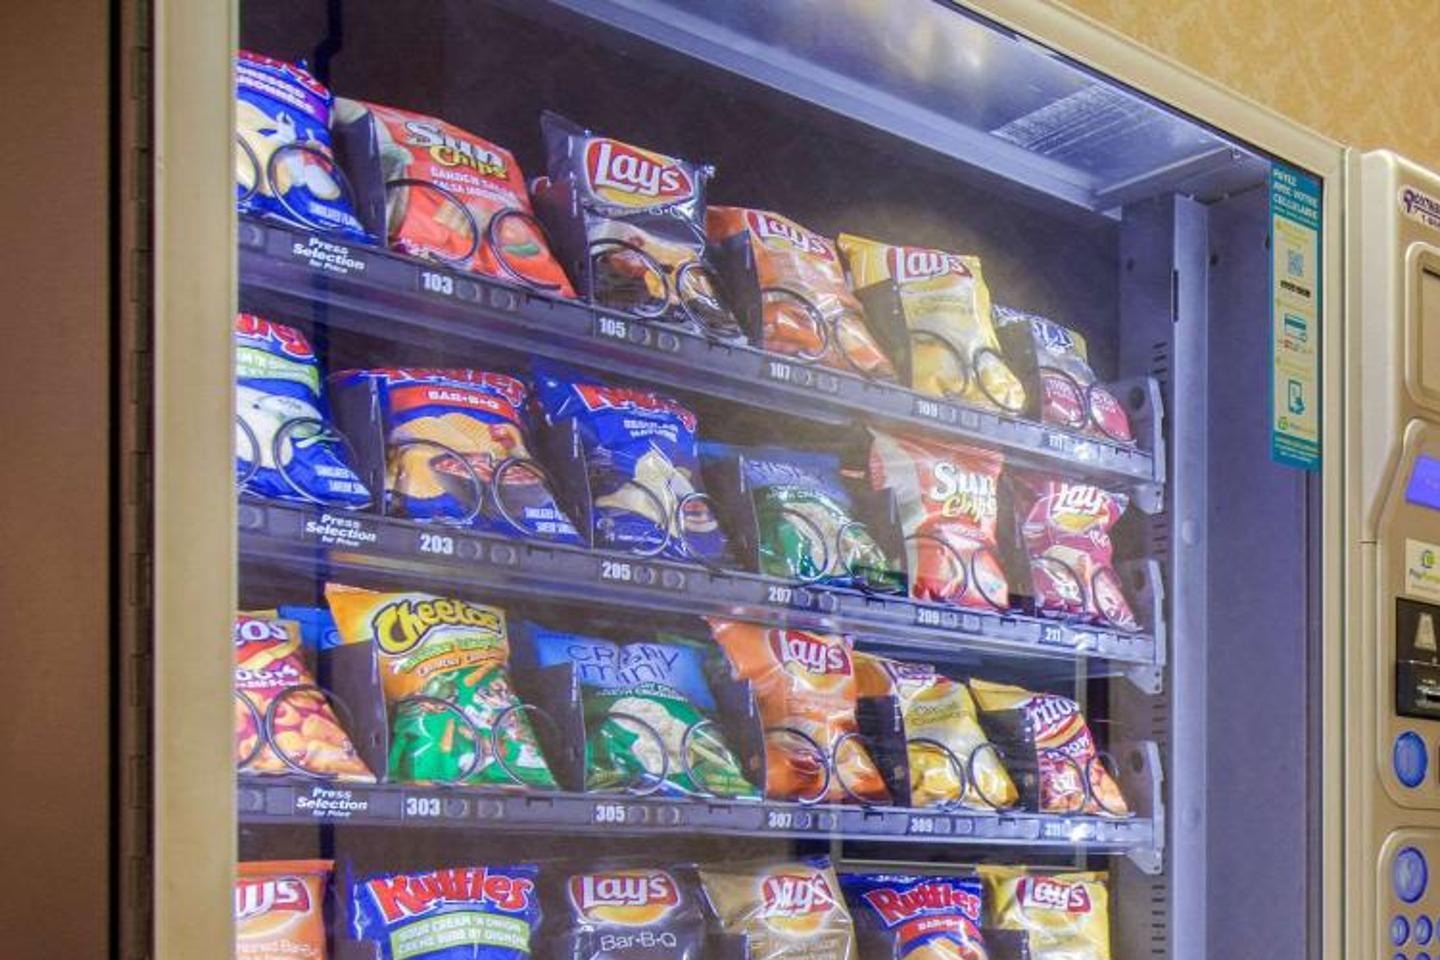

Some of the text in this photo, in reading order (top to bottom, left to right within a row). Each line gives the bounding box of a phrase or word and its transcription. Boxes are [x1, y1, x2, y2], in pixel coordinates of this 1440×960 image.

[293, 243, 365, 271] Selection
[308, 237, 349, 257] Press
[421, 272, 454, 296] 103
[599, 318, 628, 340] 105
[321, 513, 361, 531] Press
[305, 521, 377, 545] Selection
[420, 534, 454, 556] 203
[601, 561, 631, 581] 205
[372, 599, 505, 656] Cheetos
[296, 796, 369, 812] Selection
[311, 787, 353, 800] Press
[406, 798, 441, 817] 303
[596, 805, 626, 823] 305
[768, 810, 792, 828] 307
[370, 866, 535, 924] Ruffles
[866, 883, 983, 927] Ruffles
